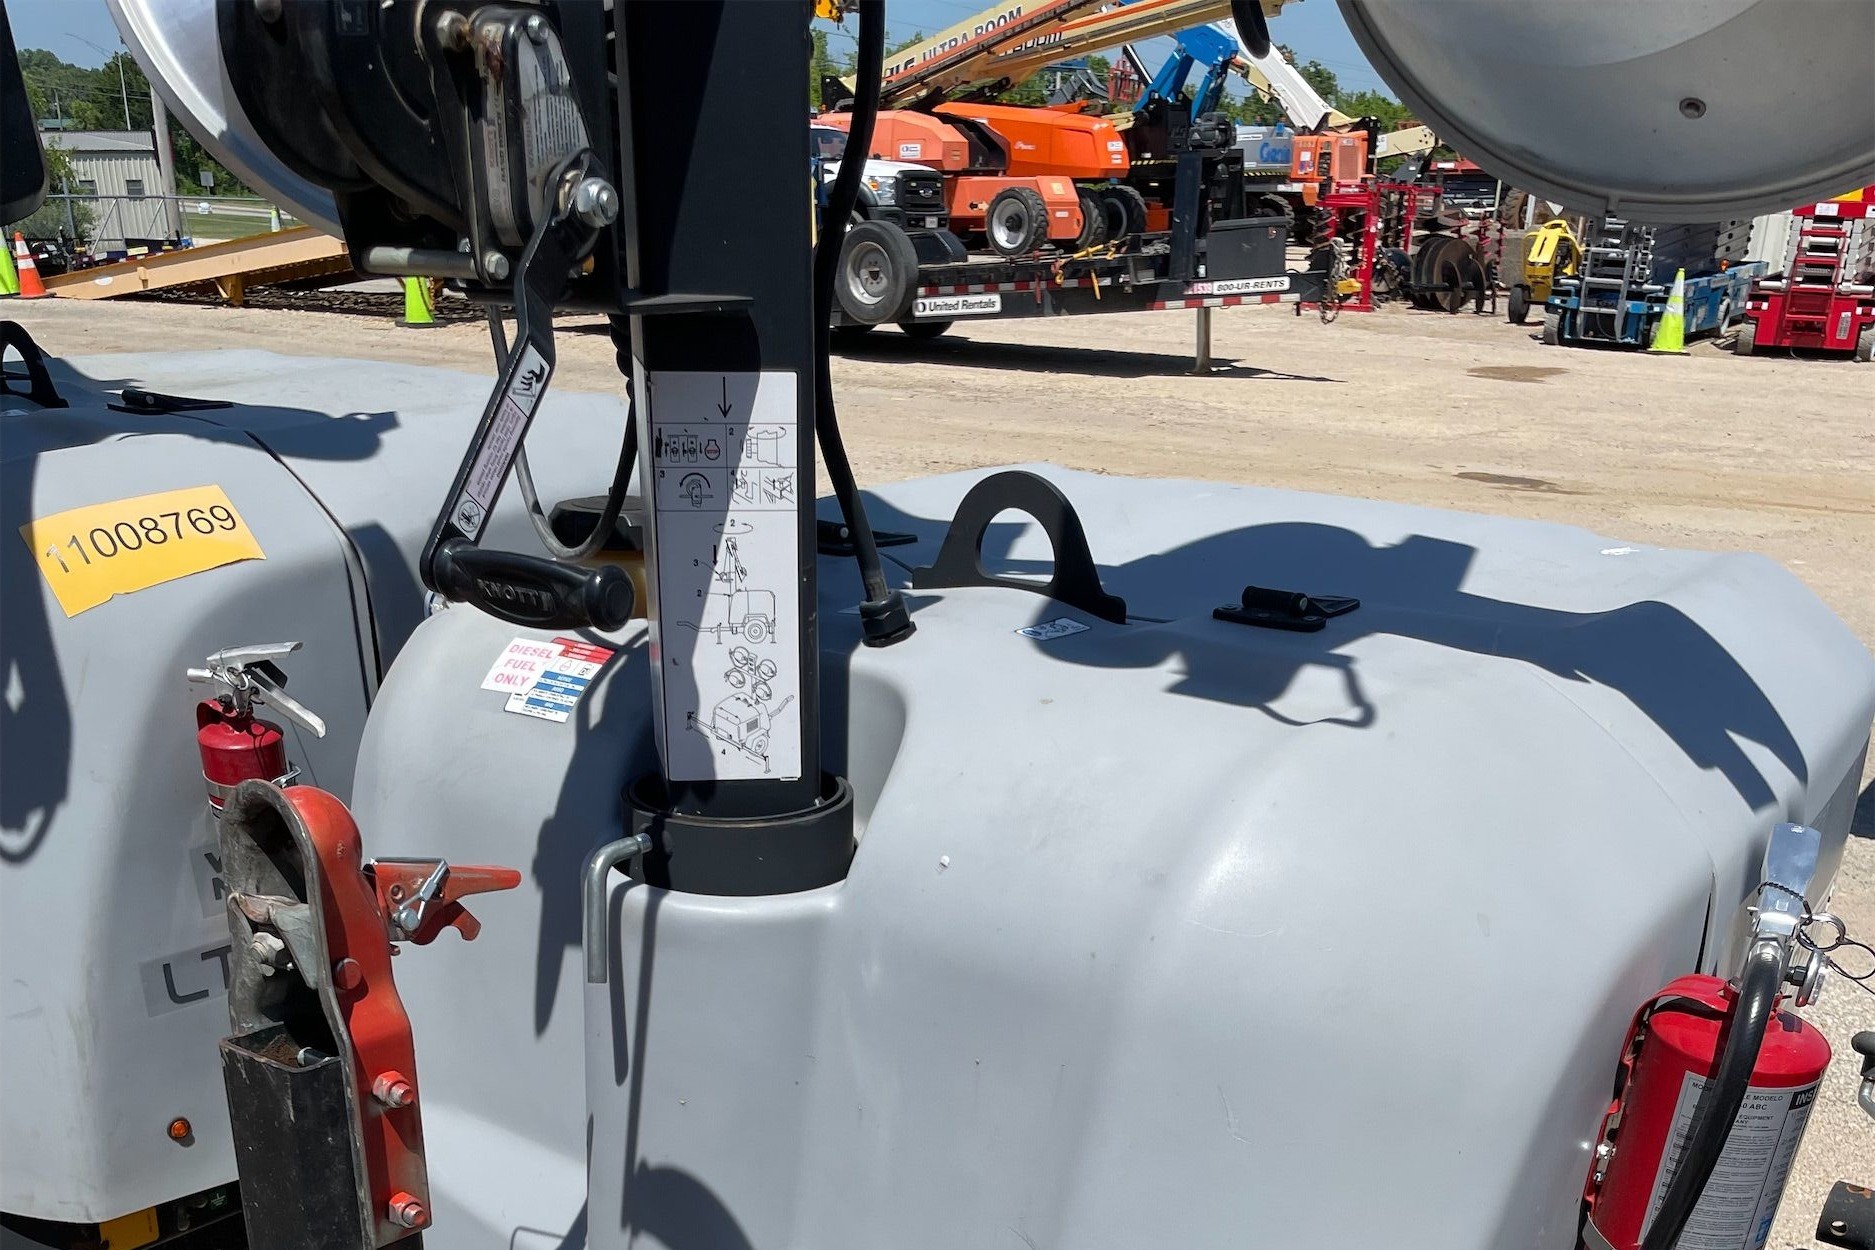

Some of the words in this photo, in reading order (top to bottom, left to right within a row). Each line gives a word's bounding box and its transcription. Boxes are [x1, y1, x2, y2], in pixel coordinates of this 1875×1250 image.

[922, 32, 969, 62] ULTRA
[974, 6, 1022, 38] BOOM
[1216, 279, 1285, 292] 800-UR-RENTS
[929, 301, 959, 312] United
[961, 298, 996, 310] Rentals
[46, 504, 237, 573] 11008769
[509, 644, 553, 659] DIESEL
[504, 658, 536, 672] FUEL
[494, 672, 531, 687] ONLY
[162, 944, 232, 1005] LT
[1795, 1090, 1815, 1106] INS
